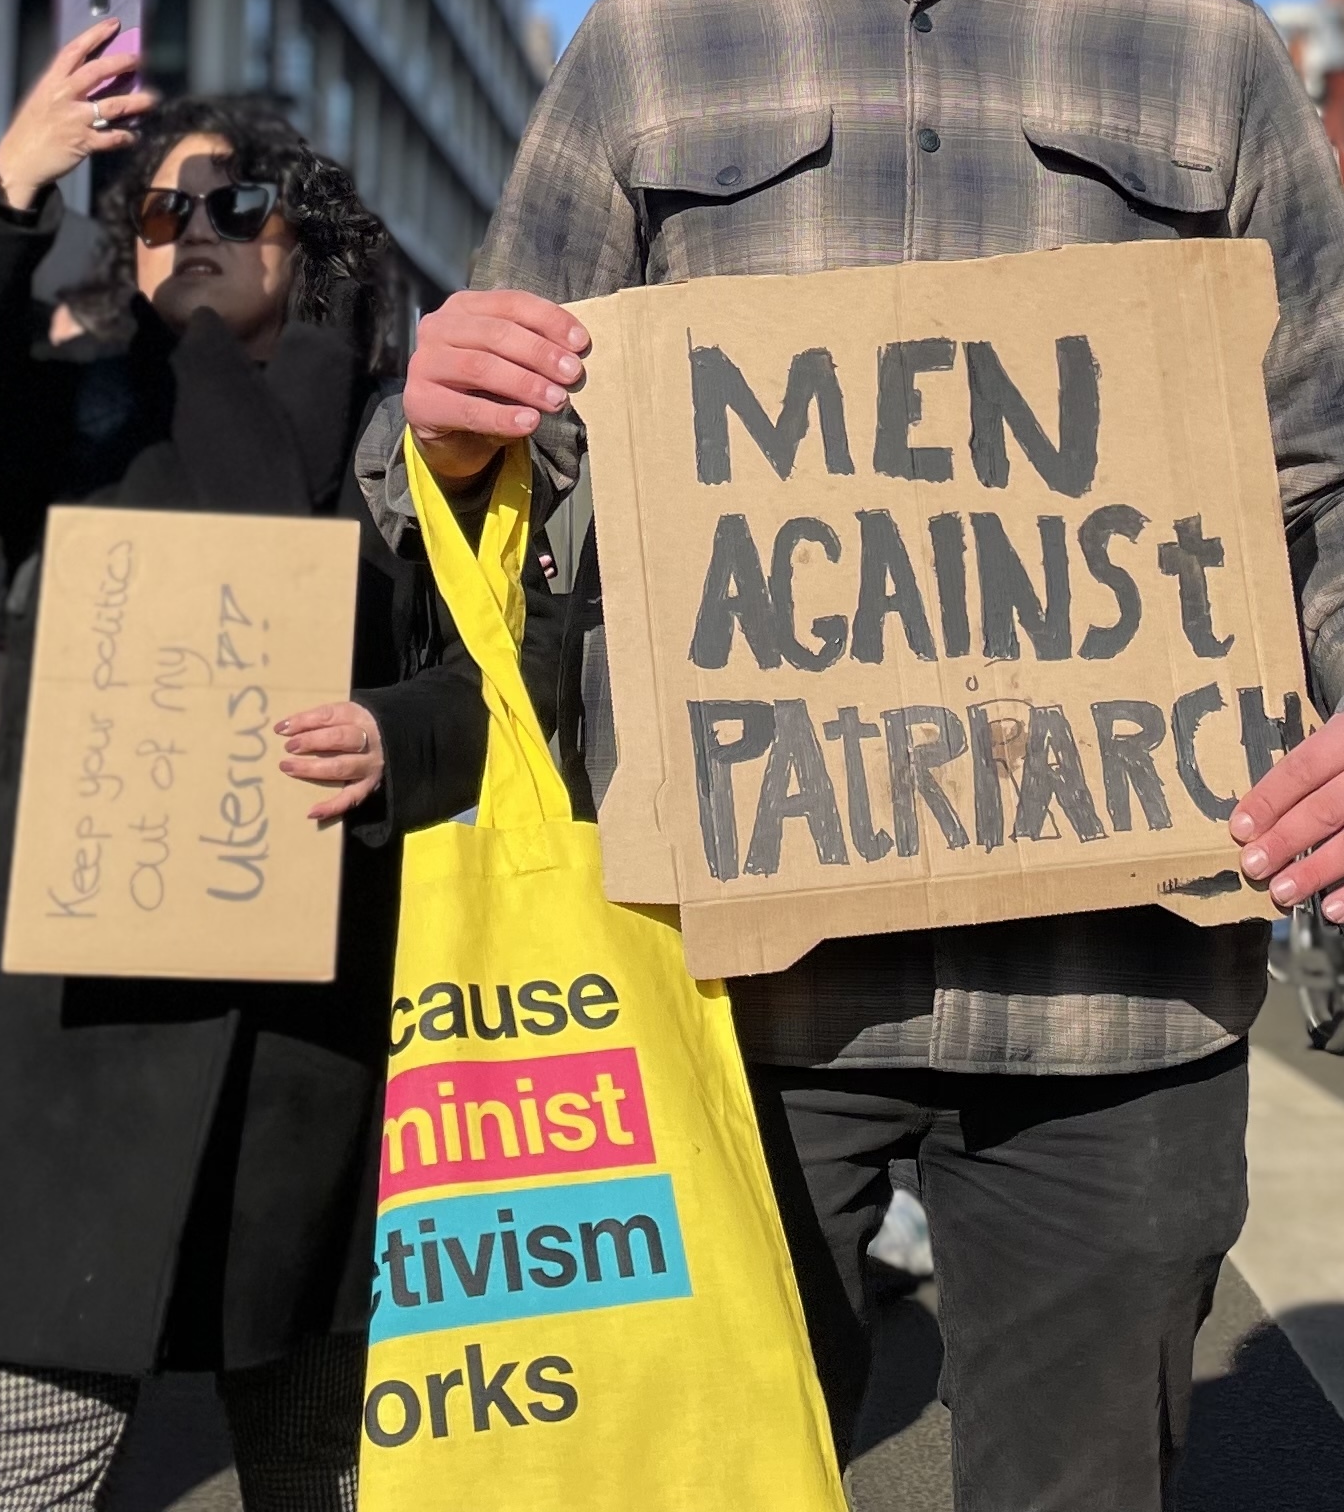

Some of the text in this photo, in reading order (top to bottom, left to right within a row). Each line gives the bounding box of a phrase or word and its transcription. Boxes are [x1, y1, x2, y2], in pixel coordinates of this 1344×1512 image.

[687, 330, 1102, 498] MEN
[45, 539, 133, 918] Keep your politics
[135, 738, 188, 790] of
[389, 973, 620, 1057] cause
[383, 1073, 635, 1175] minist
[364, 1344, 579, 1448] orks
